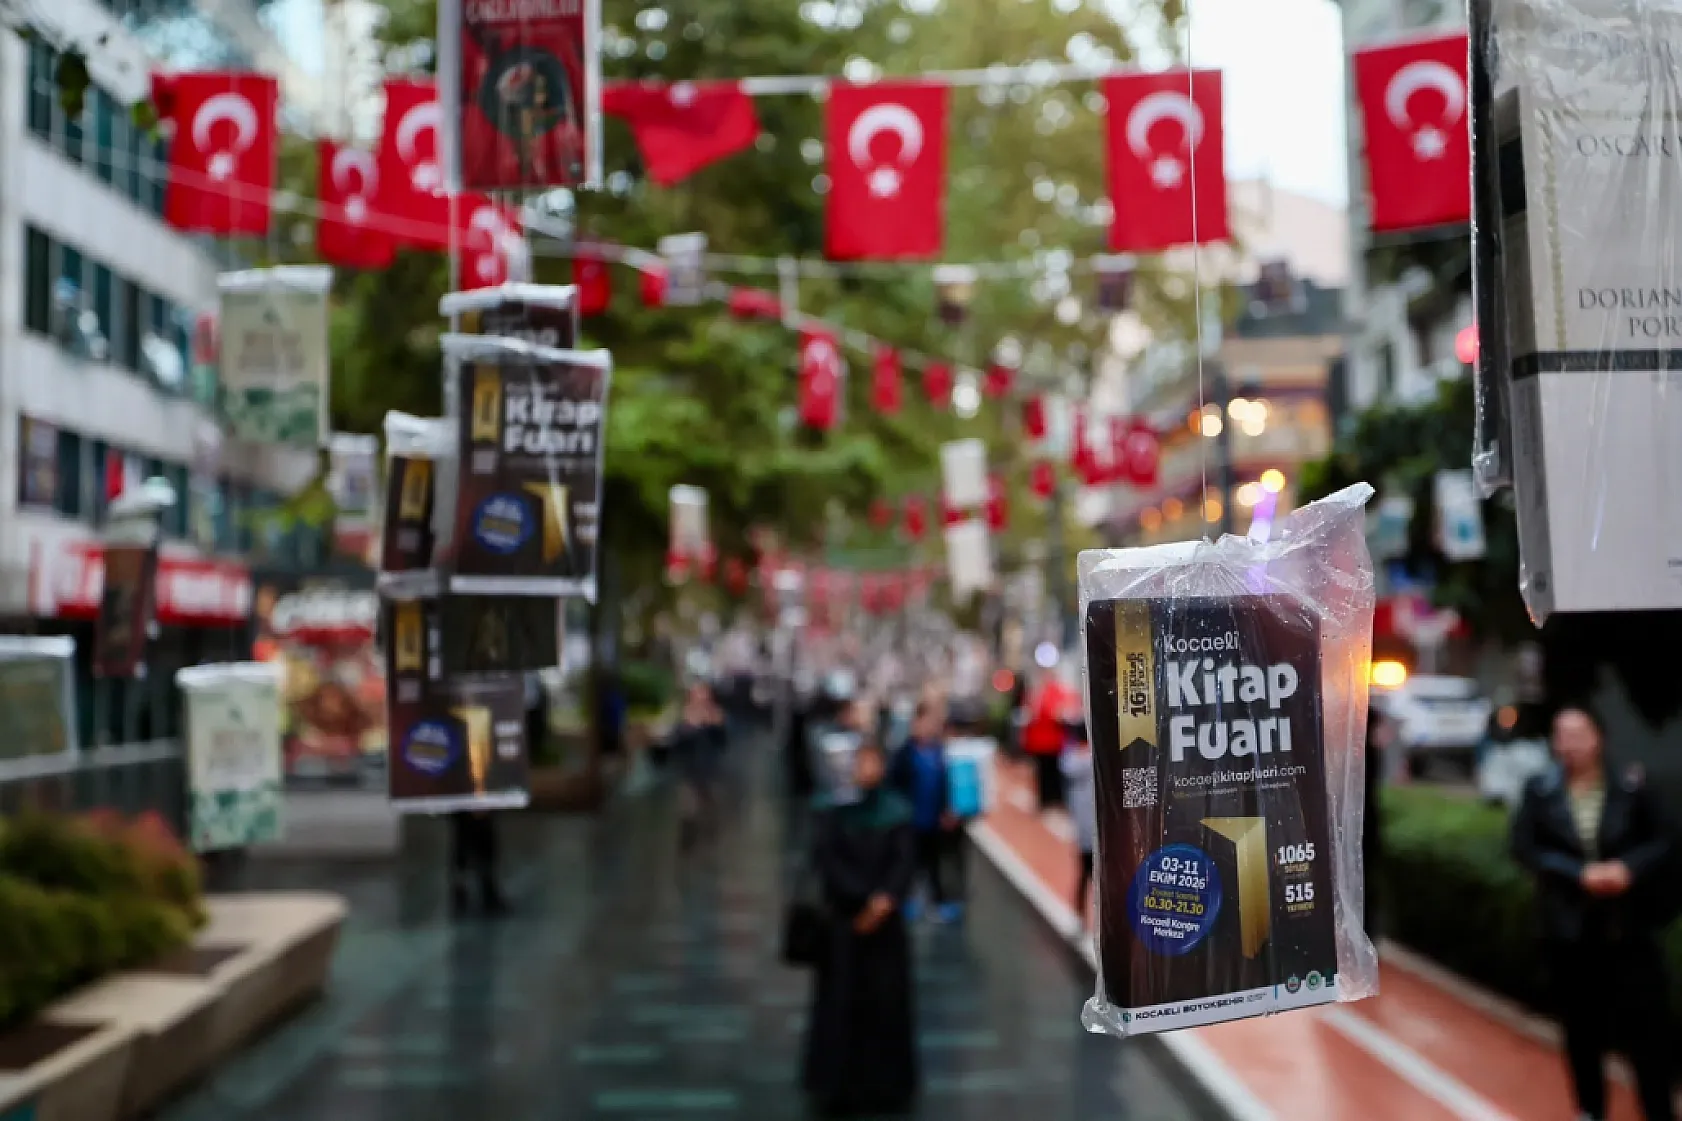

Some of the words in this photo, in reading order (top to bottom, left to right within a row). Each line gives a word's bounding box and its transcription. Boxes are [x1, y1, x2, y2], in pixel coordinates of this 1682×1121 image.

[1577, 135, 1671, 157] OSCAR
[1578, 287, 1682, 309] DORIAN
[1629, 316, 1682, 337] POR
[1164, 631, 1239, 653] Kocaeli
[1167, 657, 1298, 709] Kitap
[1170, 714, 1292, 762] Fuarı
[1278, 842, 1315, 865] 1065
[1161, 857, 1199, 875] 03-11
[1285, 882, 1315, 902] 515
[1144, 895, 1203, 915] 10.30-21.30
